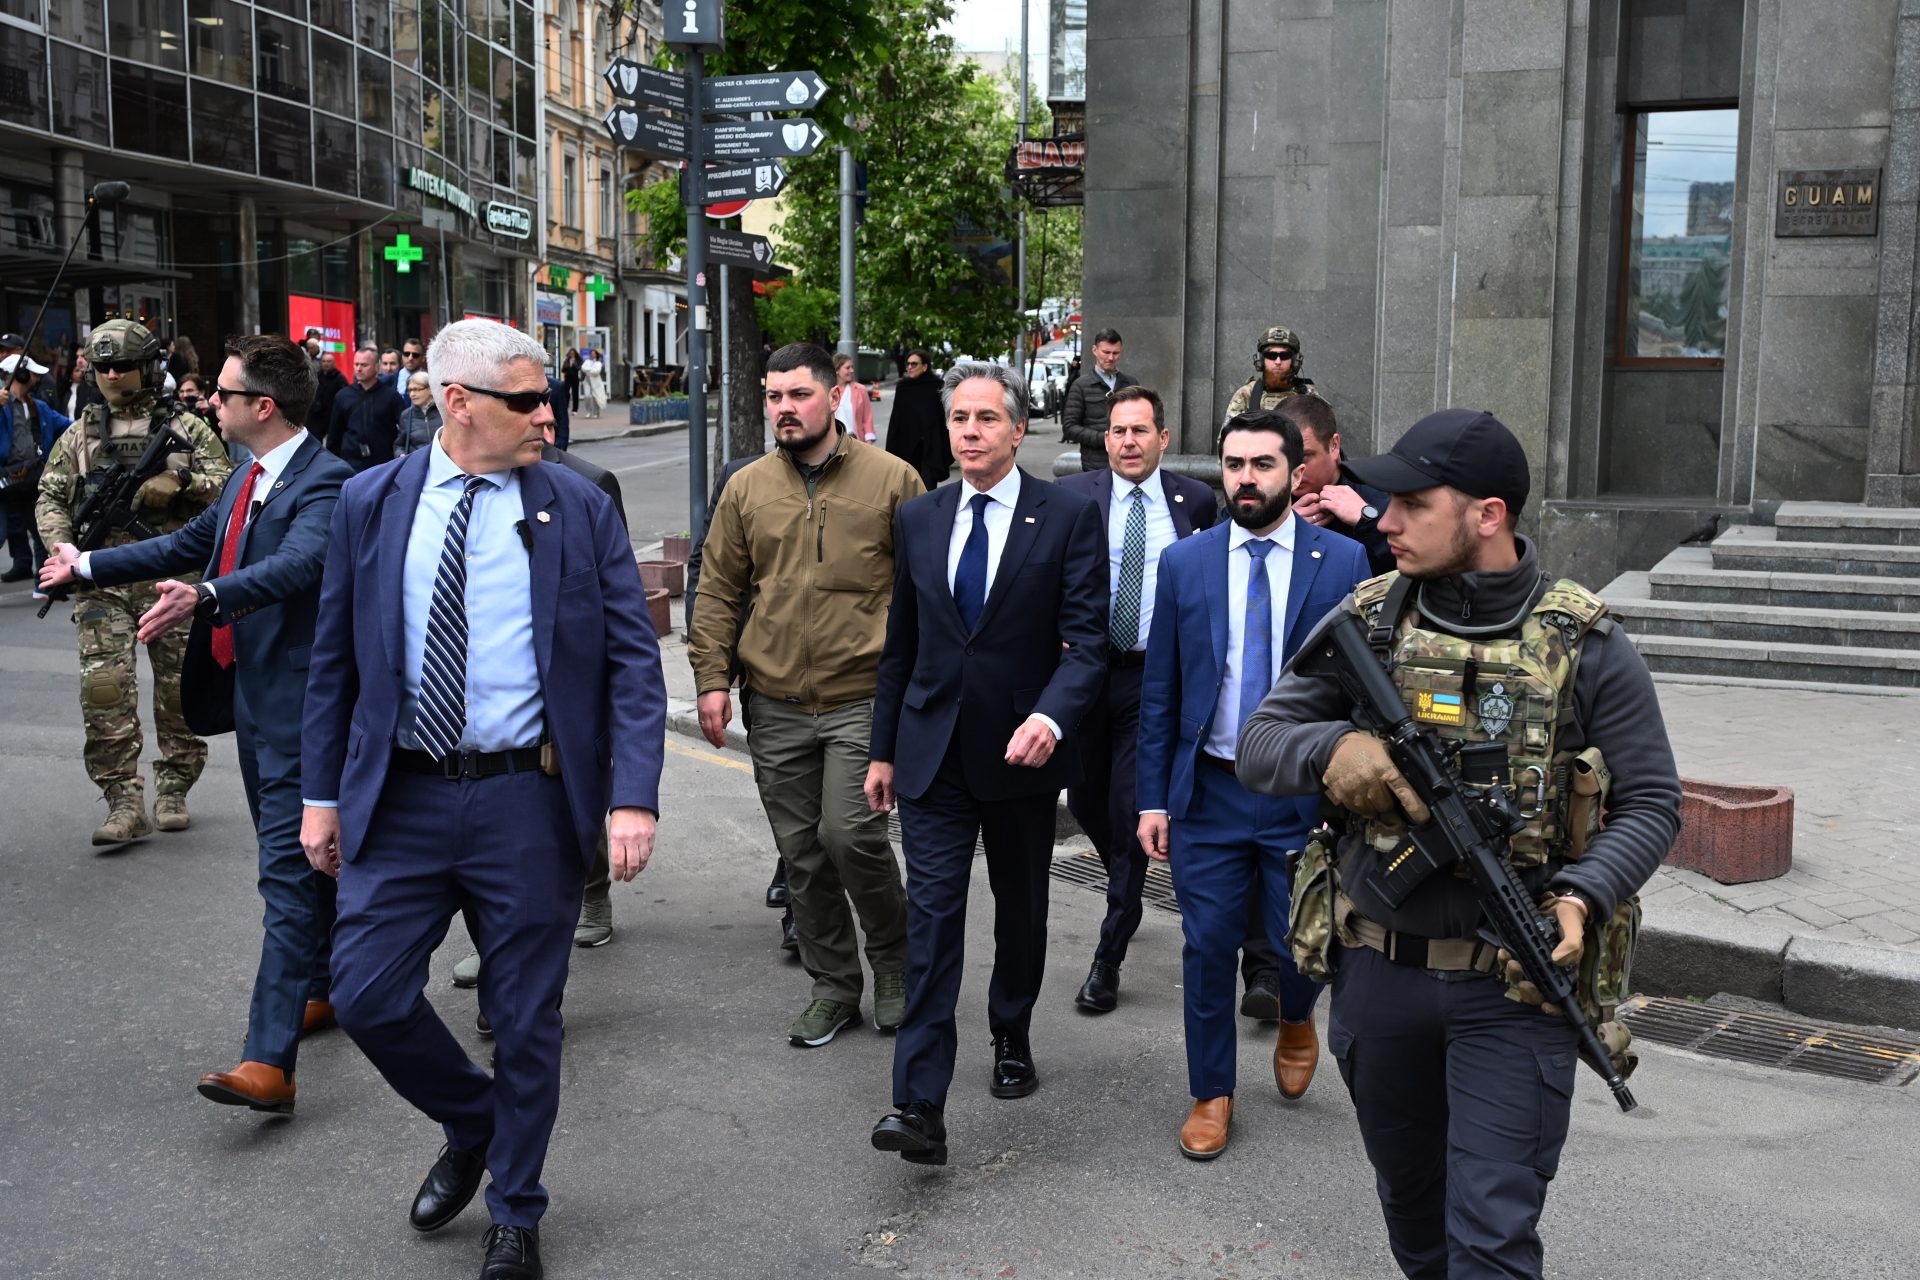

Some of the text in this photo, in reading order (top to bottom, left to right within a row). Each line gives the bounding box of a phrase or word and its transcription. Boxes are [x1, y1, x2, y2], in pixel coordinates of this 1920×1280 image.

[1017, 141, 1086, 168] ШАУ
[732, 168, 751, 177] ВОКЗАЛ
[411, 166, 446, 199] АПТЕКА
[708, 187, 747, 198] RIVER TERMINAL
[1784, 214, 1871, 226] SECRETARIAT
[1418, 711, 1459, 723] UKRAINE
